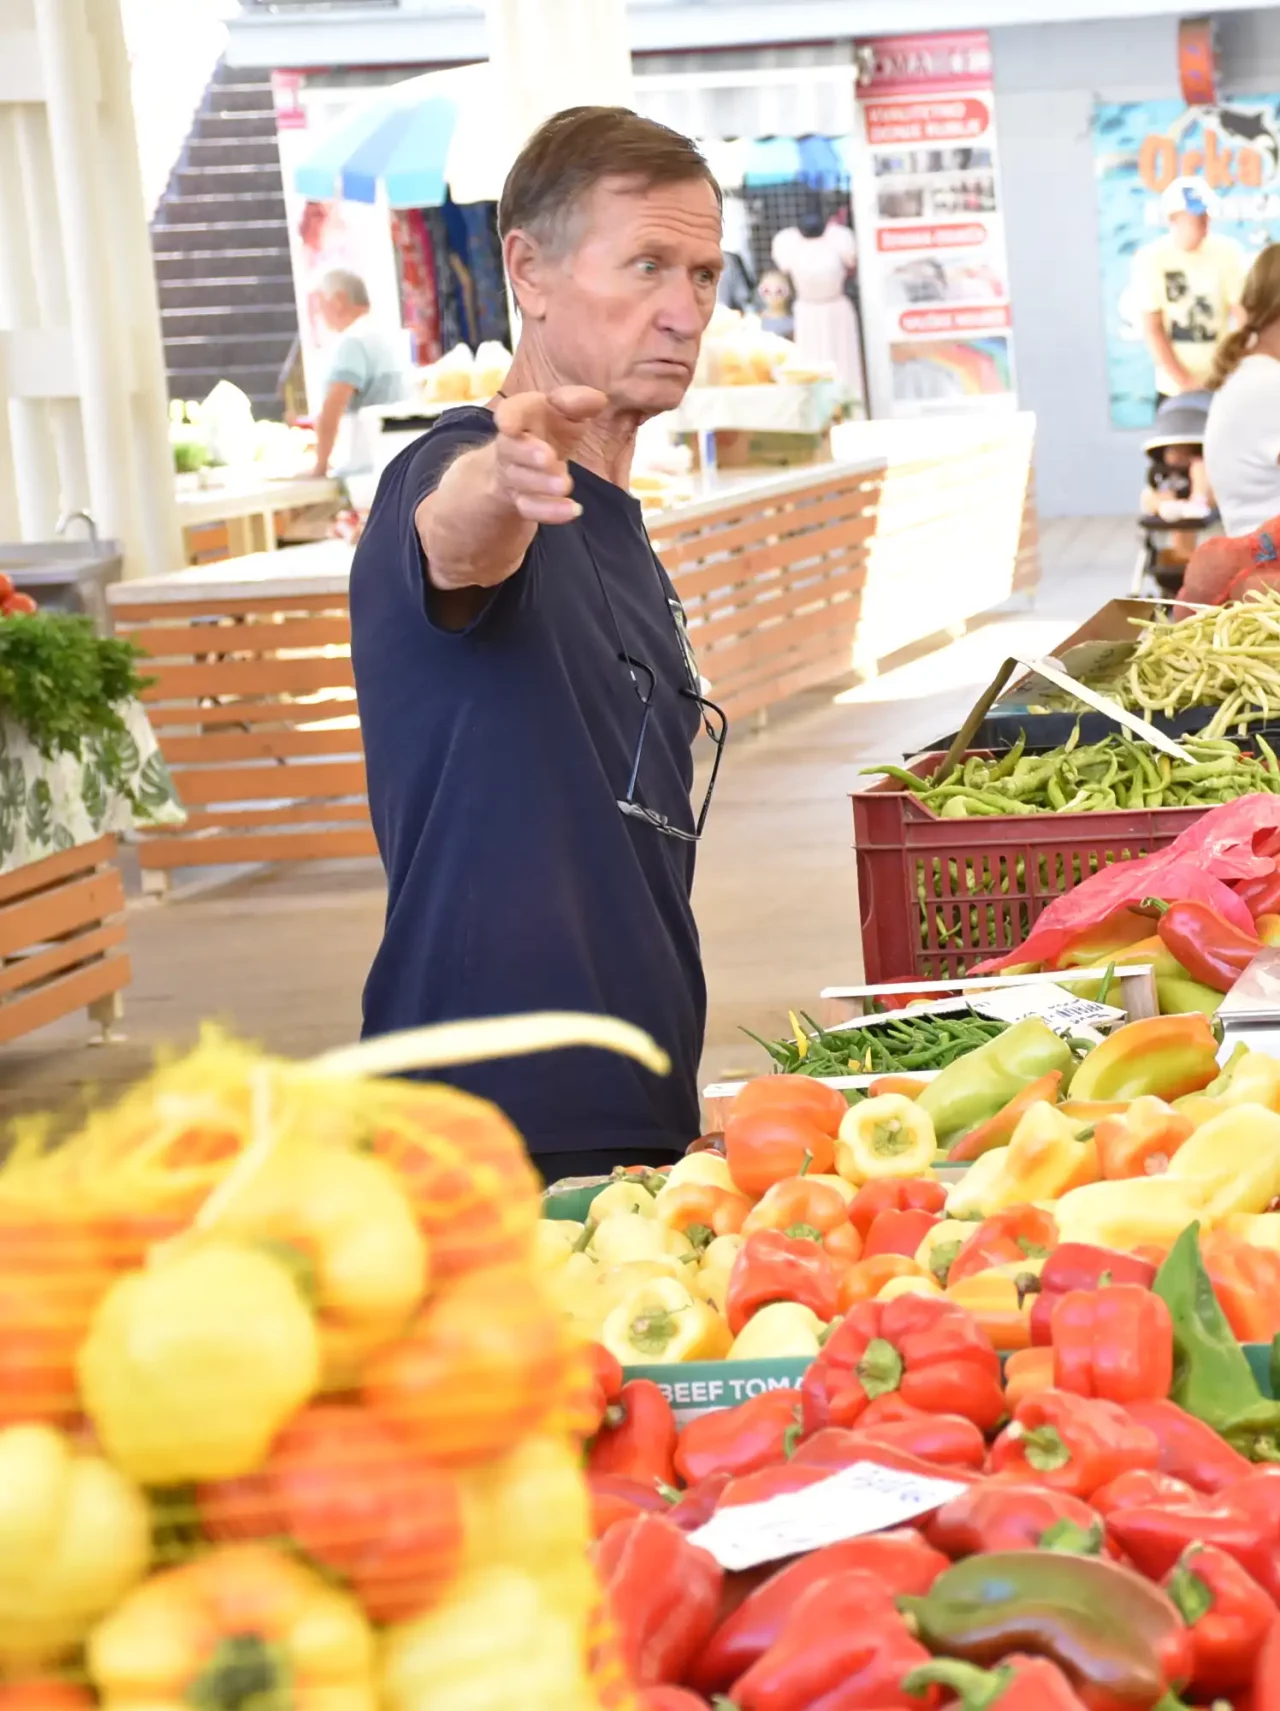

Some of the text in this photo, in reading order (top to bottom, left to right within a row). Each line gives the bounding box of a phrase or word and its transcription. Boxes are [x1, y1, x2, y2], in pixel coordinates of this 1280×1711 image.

[1137, 128, 1262, 194] Orka
[660, 1376, 804, 1403] BEEF TOM
